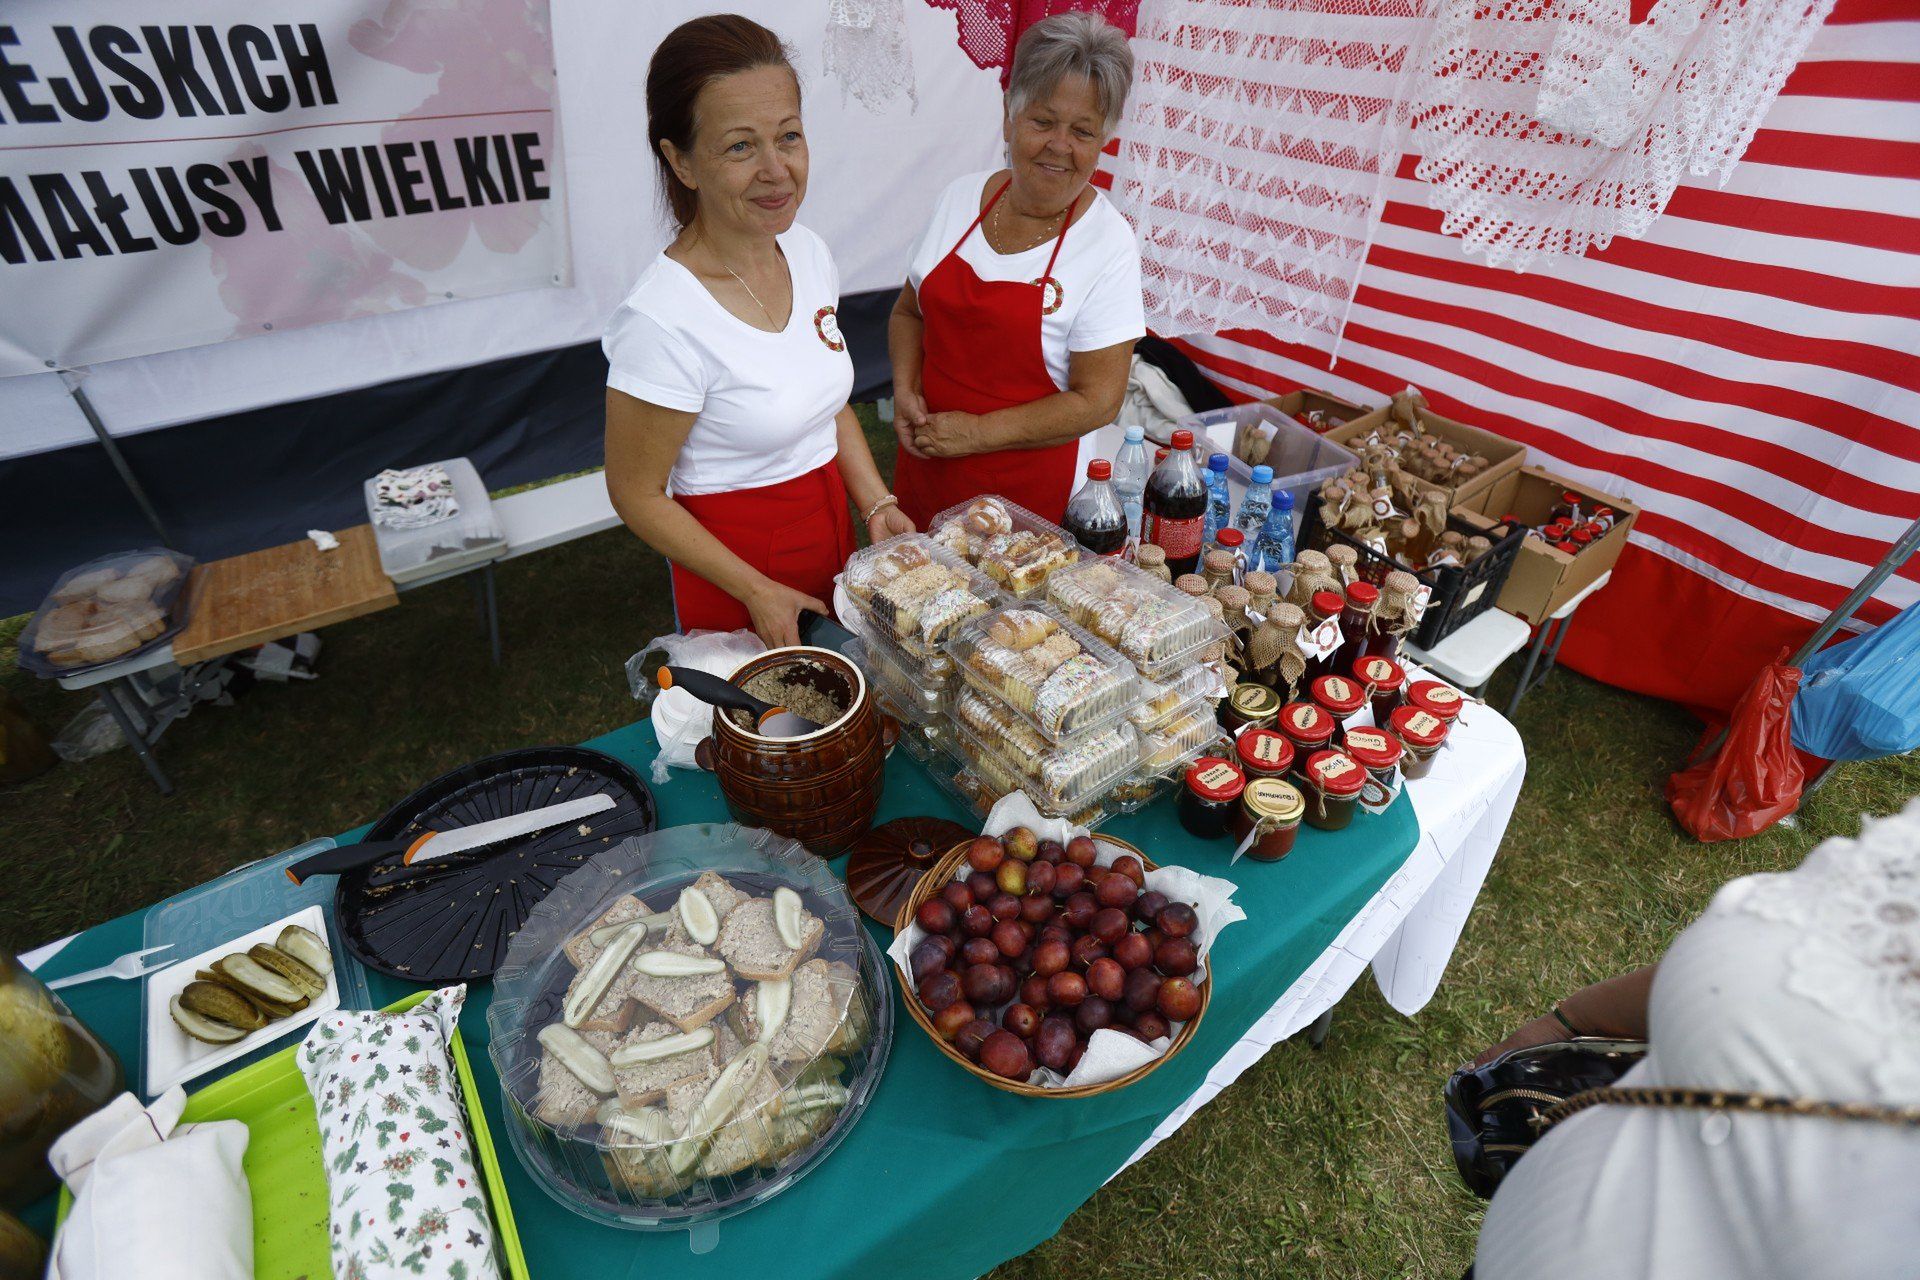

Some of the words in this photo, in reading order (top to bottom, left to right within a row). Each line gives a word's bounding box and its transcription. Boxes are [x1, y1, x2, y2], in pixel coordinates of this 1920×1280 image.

[0, 24, 339, 125] EJSKICH
[0, 155, 283, 265] MAŁUSY
[294, 132, 550, 225] WIELKIE
